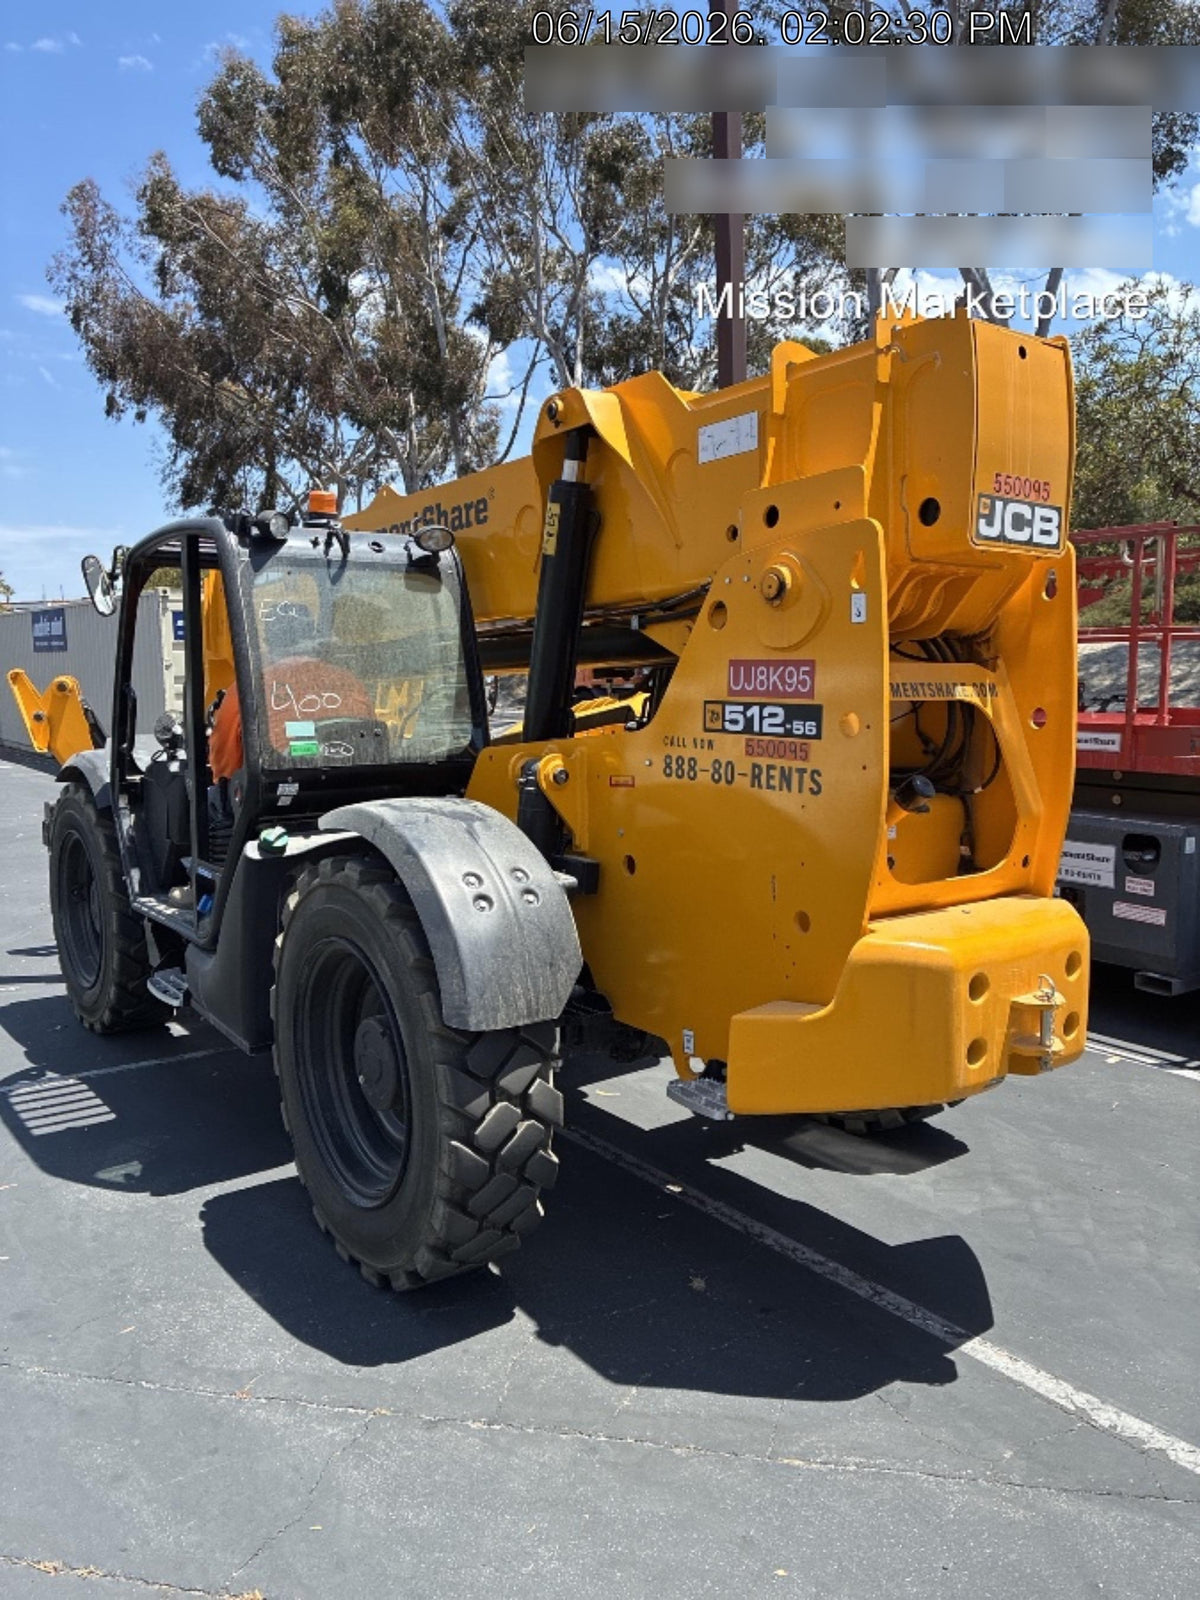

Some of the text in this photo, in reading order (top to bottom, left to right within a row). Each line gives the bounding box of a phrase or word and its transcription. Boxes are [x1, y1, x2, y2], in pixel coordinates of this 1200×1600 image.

[993, 472, 1050, 501] 550095
[978, 499, 1060, 545] JCB
[730, 666, 811, 692] UJ8K95
[723, 704, 818, 736] 512-56
[663, 736, 715, 751] CALL NOW
[663, 755, 823, 796] 888-80-RENTS
